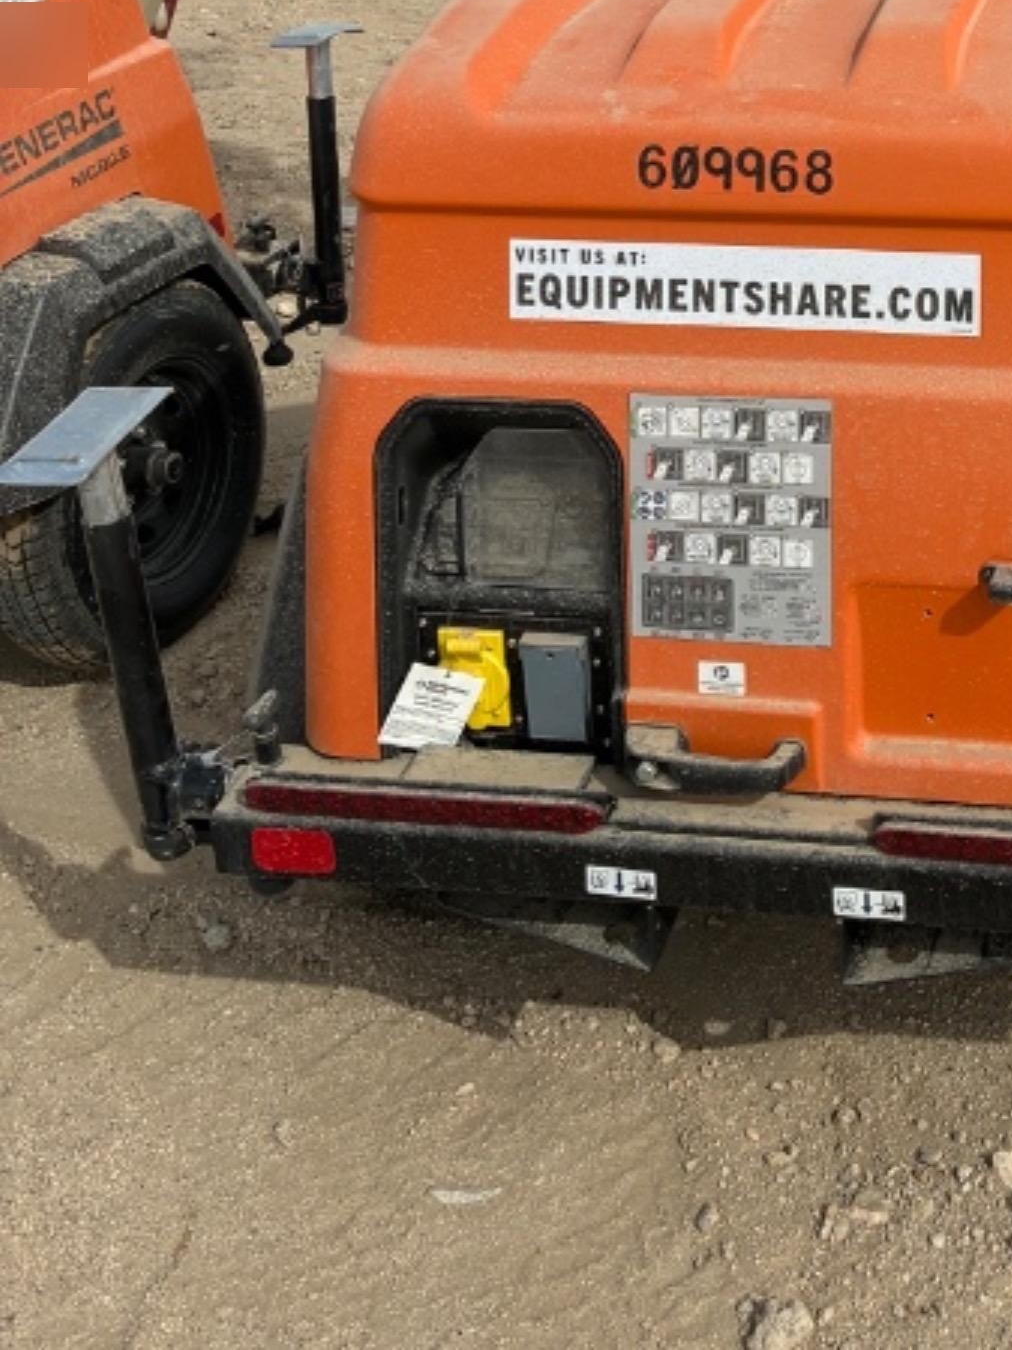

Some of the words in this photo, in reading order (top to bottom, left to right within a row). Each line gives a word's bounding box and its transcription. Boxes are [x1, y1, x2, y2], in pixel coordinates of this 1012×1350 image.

[637, 144, 834, 195] 609968
[515, 247, 570, 265] VISIT
[580, 249, 605, 266] US
[615, 250, 646, 267] AT:
[515, 272, 974, 324] EQUIPMENTSHARE.COM
